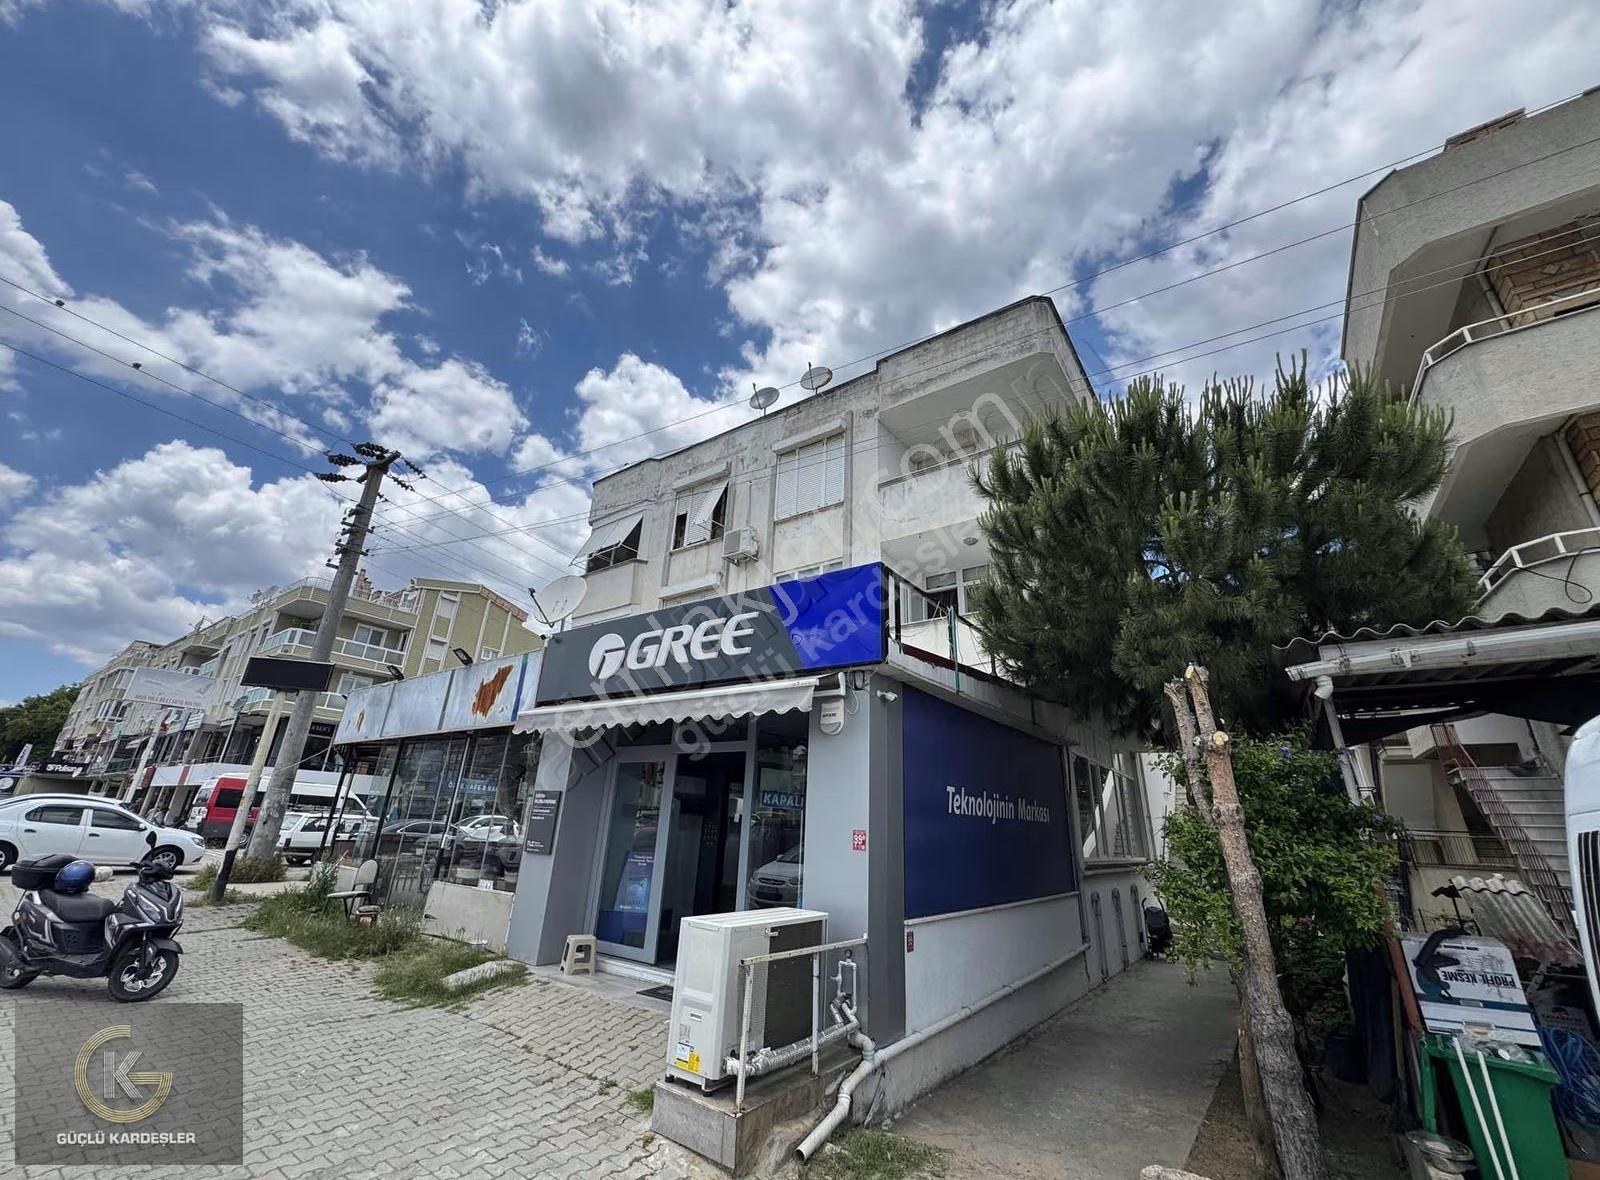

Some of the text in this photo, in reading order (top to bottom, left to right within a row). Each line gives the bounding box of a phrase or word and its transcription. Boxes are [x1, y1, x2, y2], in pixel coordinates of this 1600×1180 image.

[626, 611, 757, 671] GREE
[763, 791, 805, 808] KAPALI
[946, 786, 1050, 825] Teknolojinin Markası
